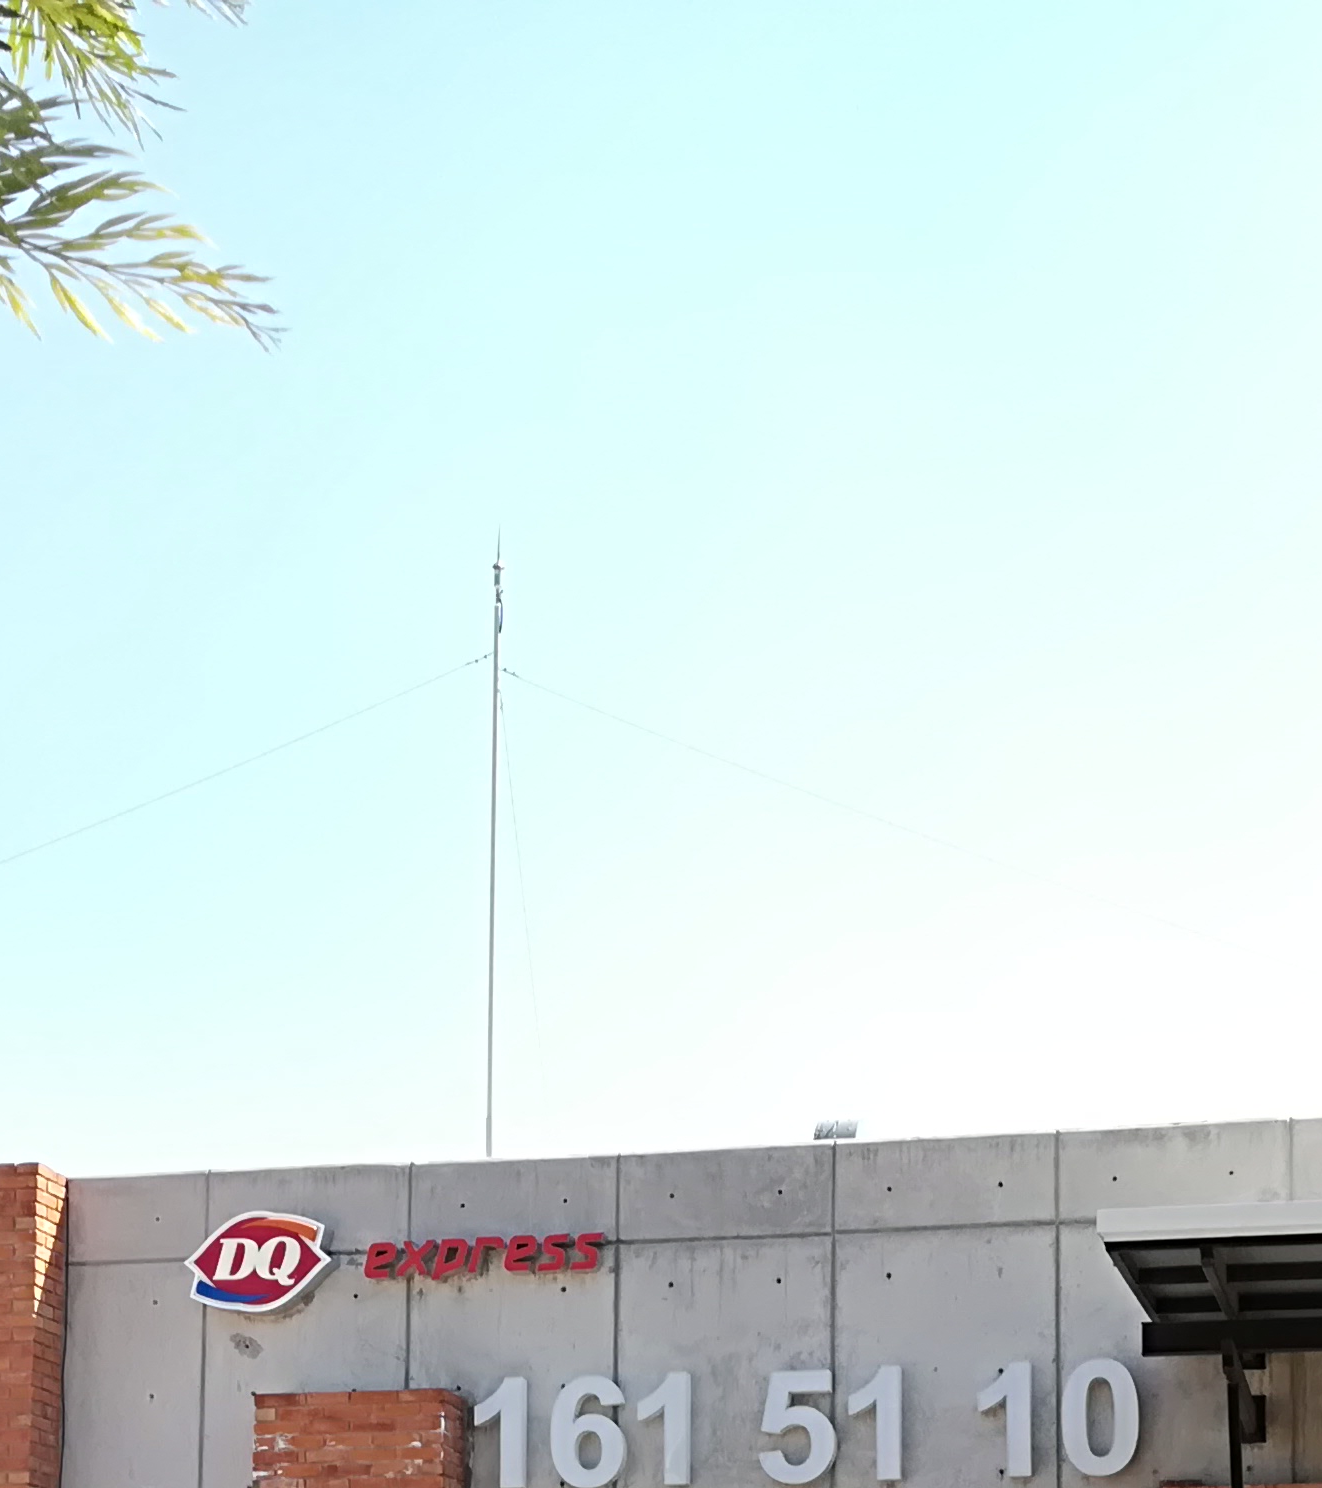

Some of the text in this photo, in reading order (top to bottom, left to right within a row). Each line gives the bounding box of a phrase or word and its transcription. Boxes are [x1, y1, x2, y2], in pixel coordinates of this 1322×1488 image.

[211, 1236, 302, 1286] DQ
[363, 1231, 606, 1281] express
[474, 1357, 1140, 1488] 161 51 10
